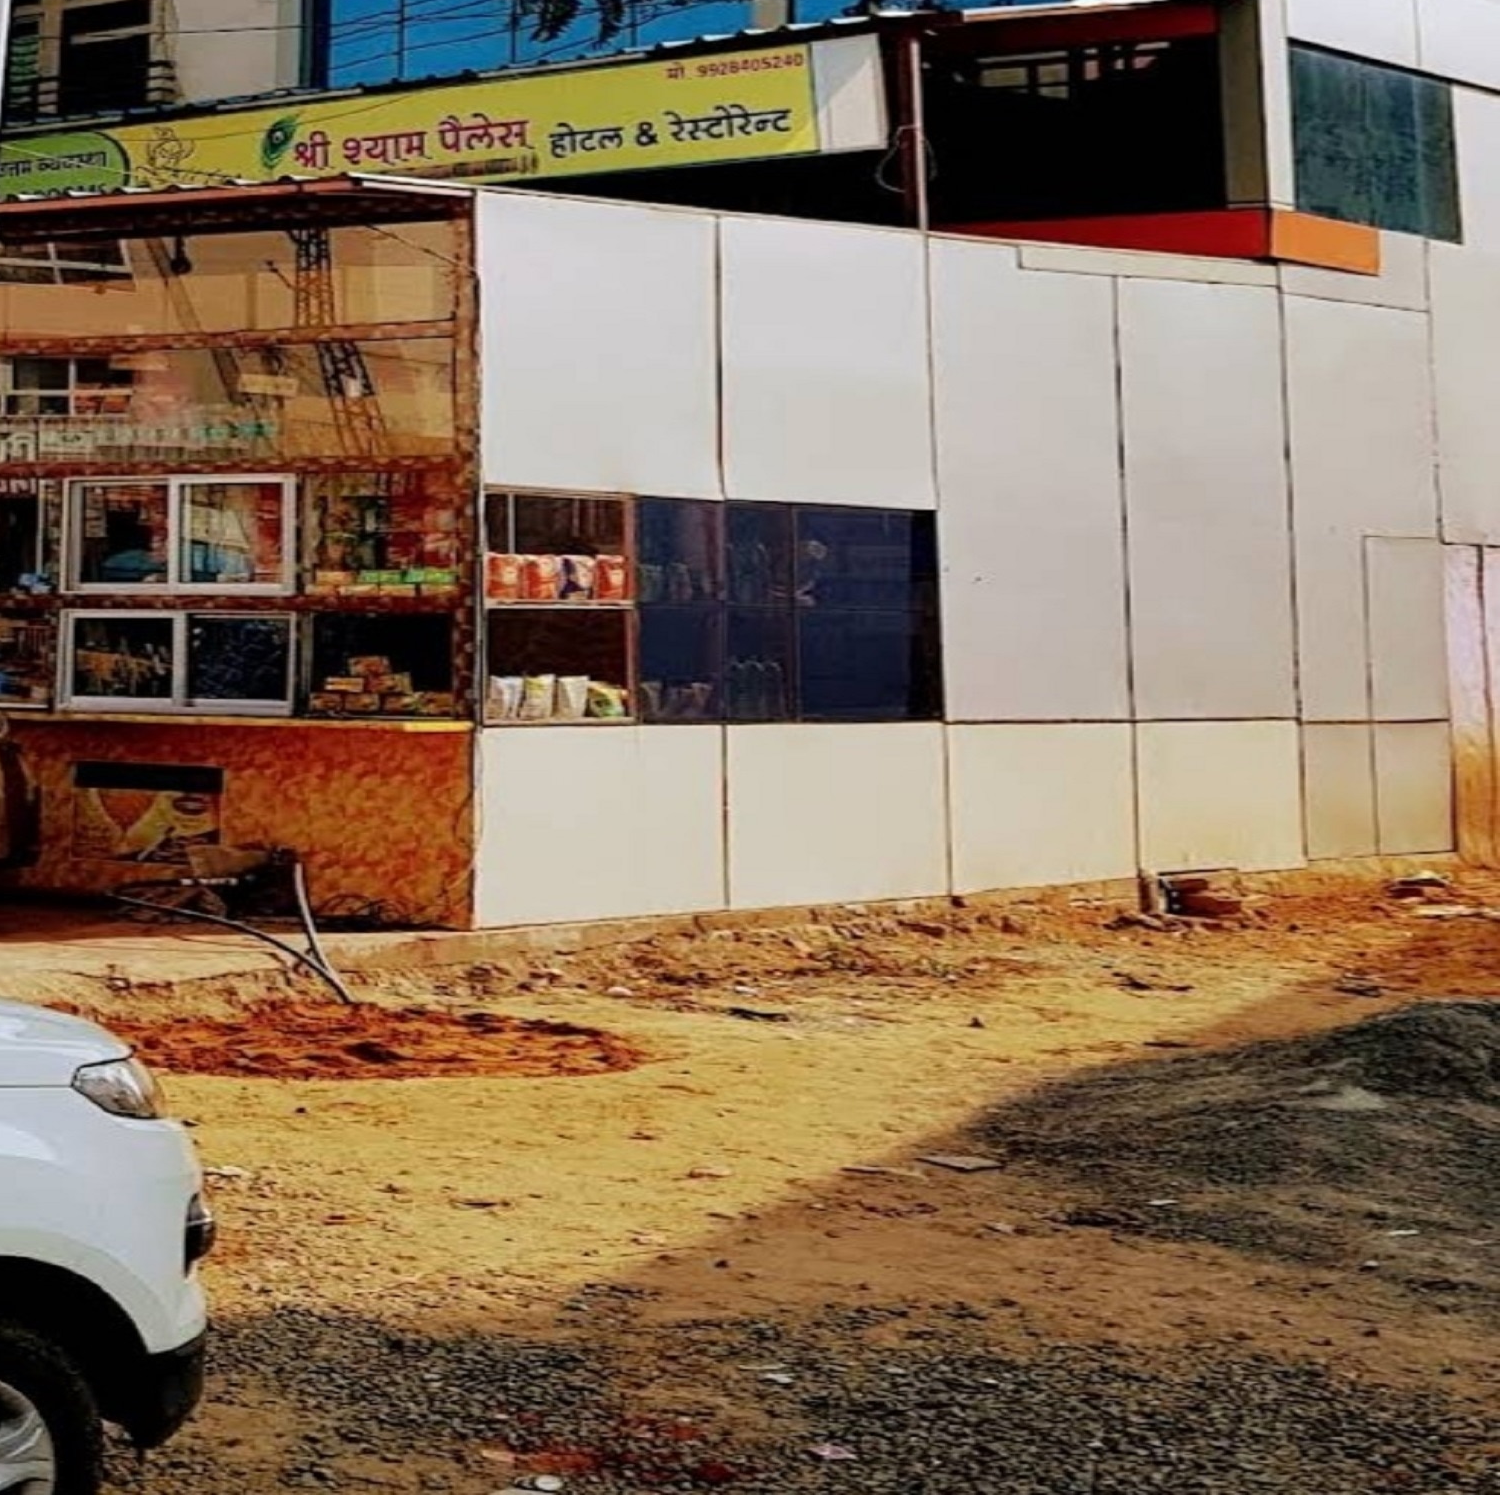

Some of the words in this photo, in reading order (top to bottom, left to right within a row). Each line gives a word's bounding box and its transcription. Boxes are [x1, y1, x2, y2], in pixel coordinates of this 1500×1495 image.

[293, 130, 335, 170] श्री
[342, 130, 433, 166] श्याम
[438, 112, 534, 153] पैलेस
[549, 122, 623, 159] होटल
[635, 121, 658, 147] &
[663, 104, 792, 143] रेस्टोरेन्ट
